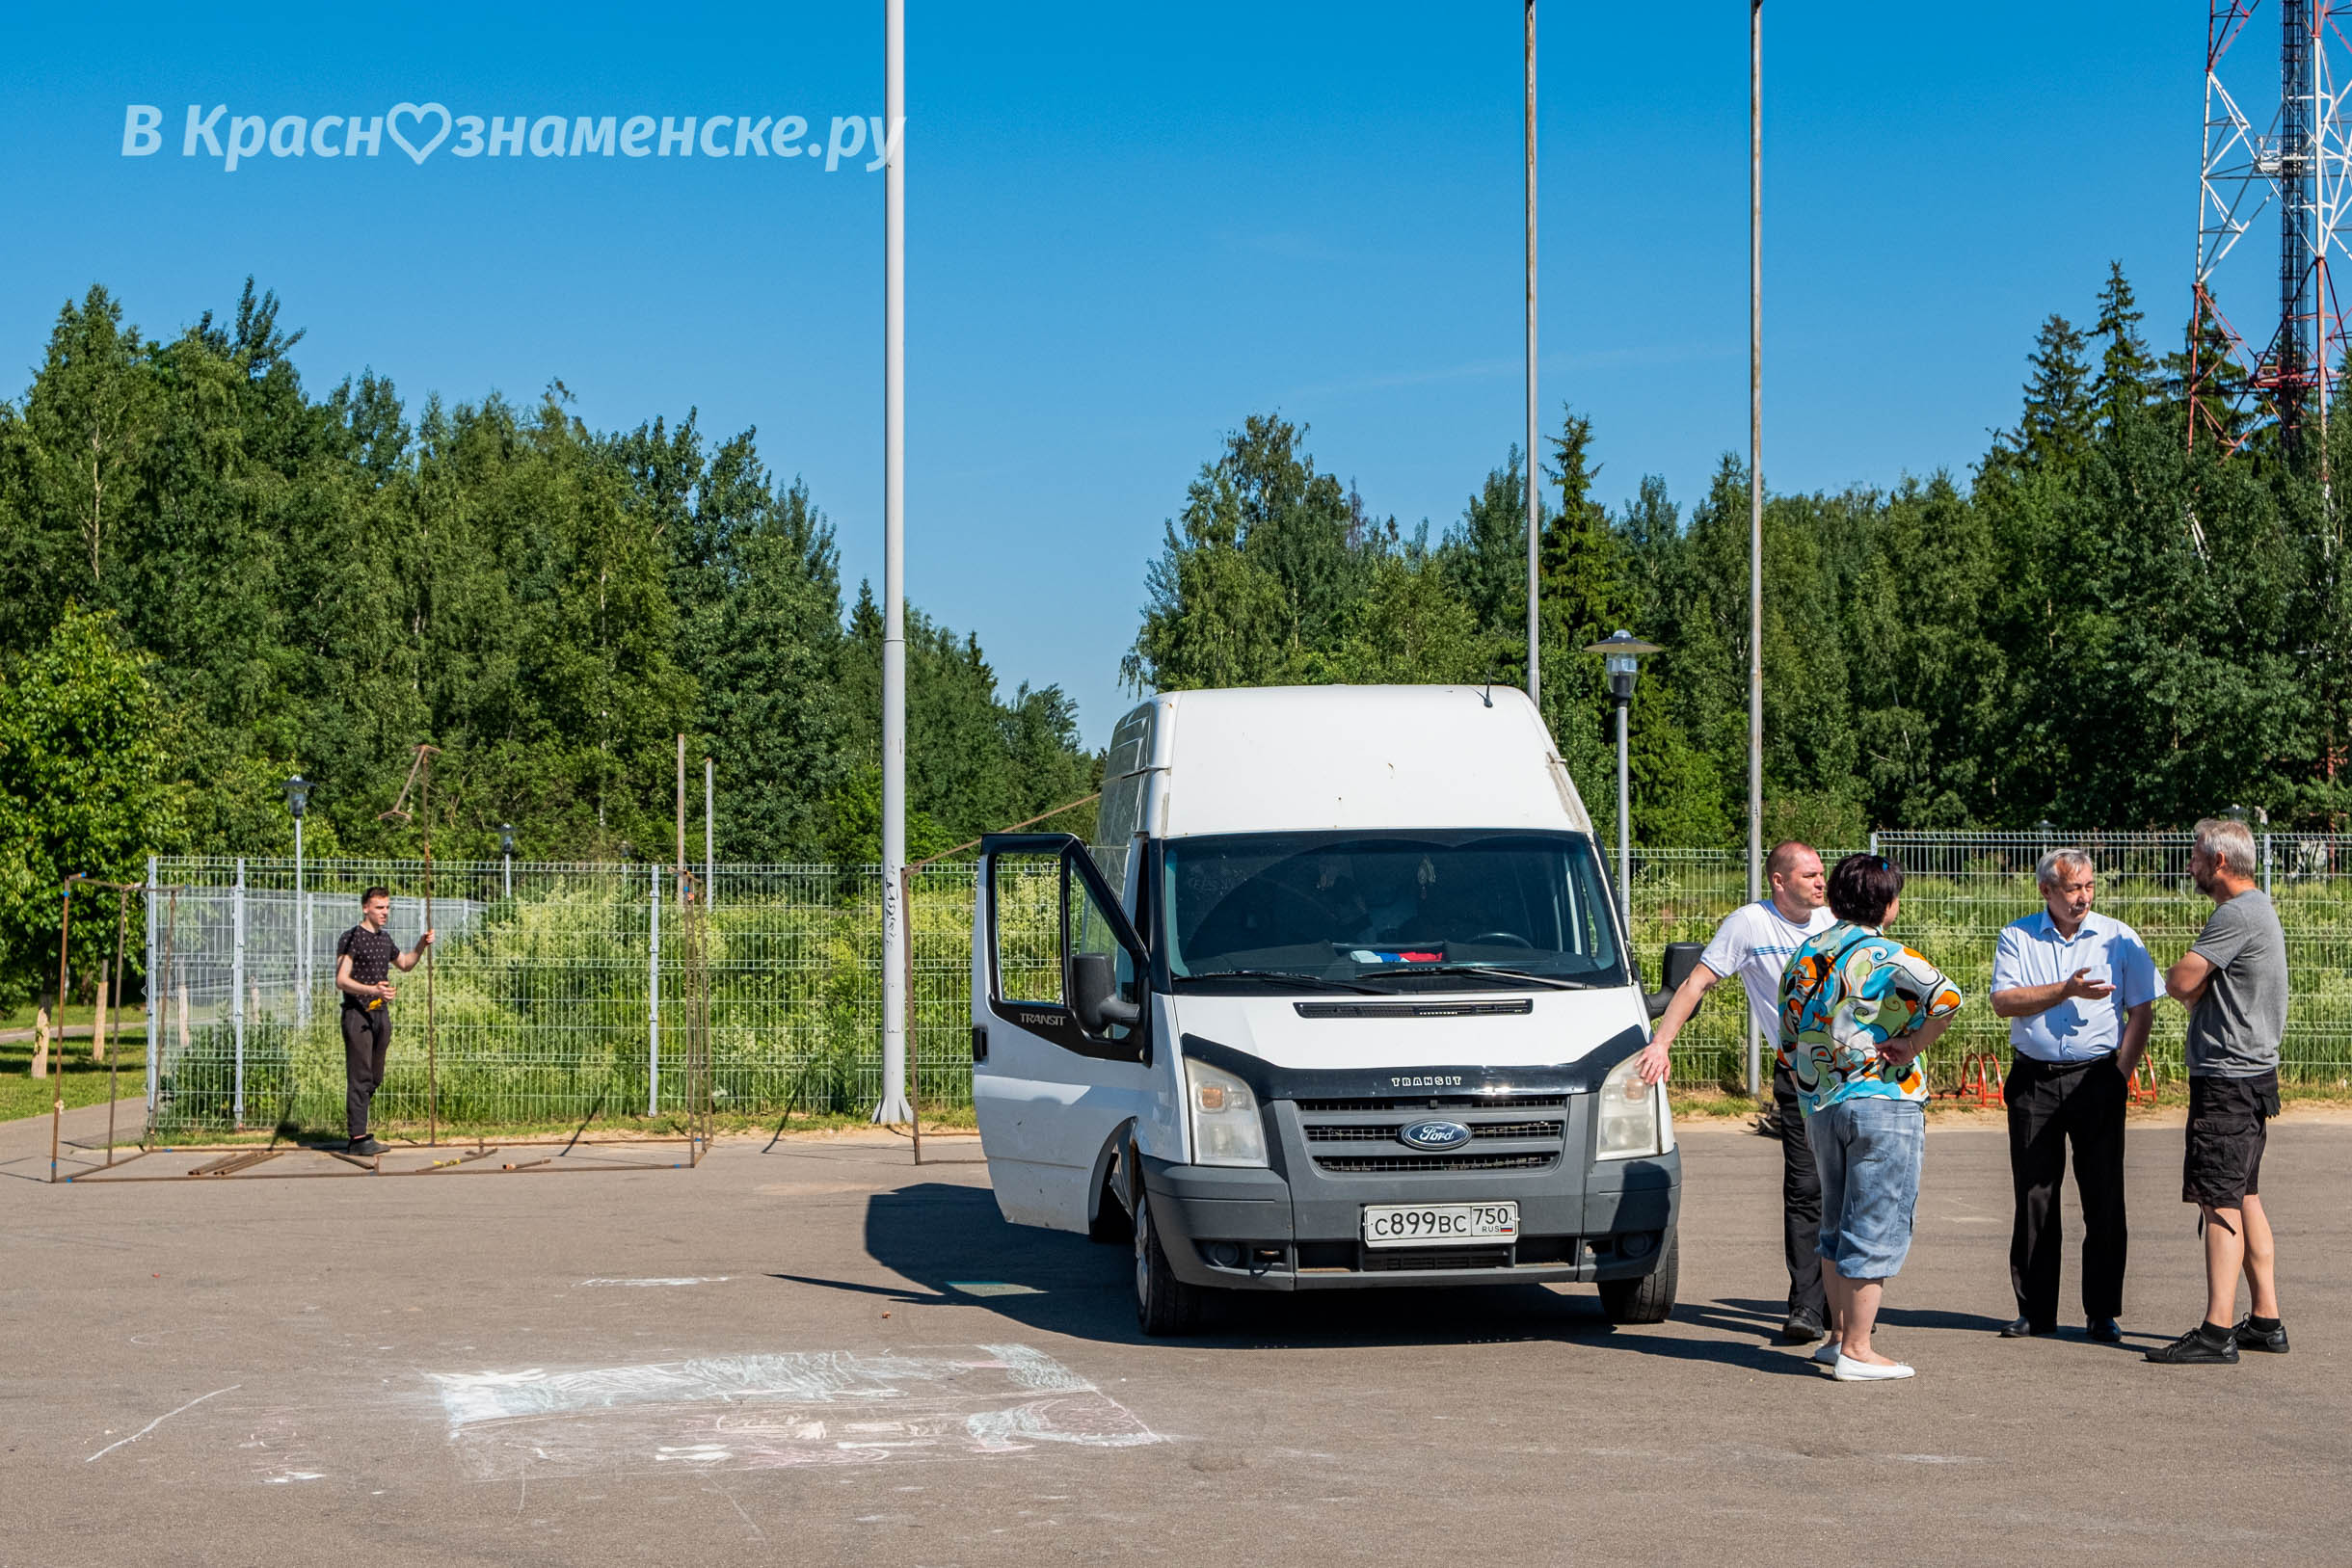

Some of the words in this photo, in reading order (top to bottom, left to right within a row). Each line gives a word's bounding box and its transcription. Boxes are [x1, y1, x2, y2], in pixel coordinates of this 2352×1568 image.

[1020, 1012, 1067, 1026] TRANSIT
[1391, 1076, 1462, 1087] TRANSIT
[1419, 1125, 1455, 1142] Ford
[1473, 1208, 1510, 1226] 750
[1482, 1225, 1500, 1234] RUS
